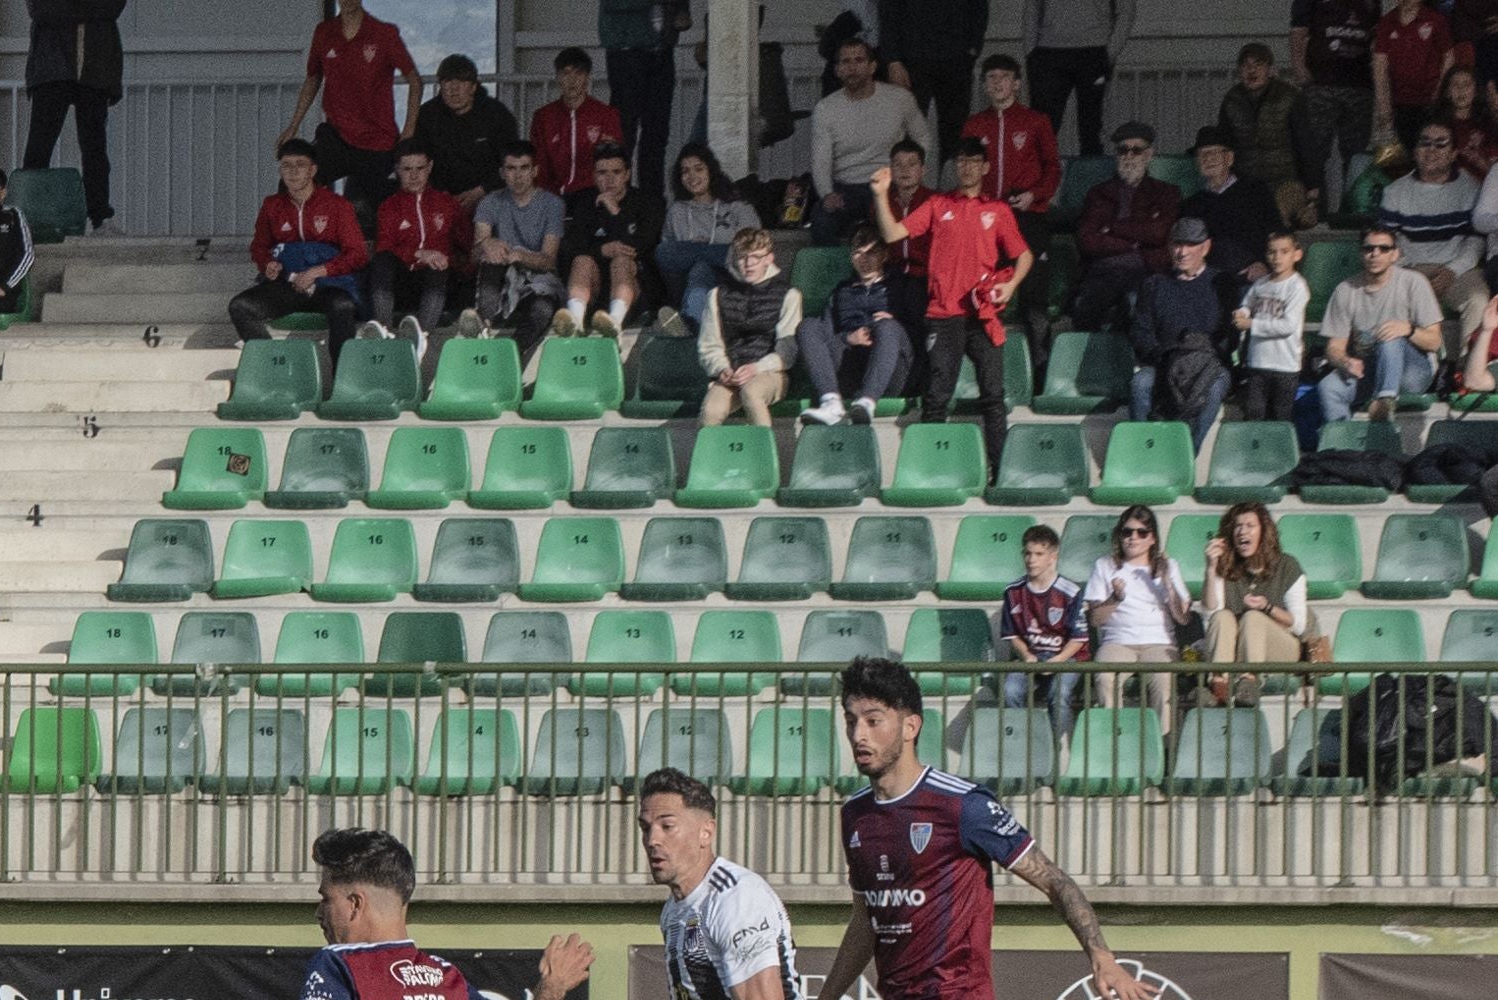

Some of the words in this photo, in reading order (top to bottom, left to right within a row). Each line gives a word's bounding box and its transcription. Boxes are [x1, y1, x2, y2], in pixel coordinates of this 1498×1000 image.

[143, 325, 161, 349] 6
[271, 355, 287, 366] 18
[370, 354, 386, 365] 17
[473, 355, 489, 366] 16
[572, 355, 587, 366] 15
[319, 444, 336, 455] 17
[422, 444, 437, 455] 16
[521, 444, 537, 455] 15
[261, 536, 276, 547] 17
[368, 534, 384, 545] 16
[468, 535, 485, 547] 15
[574, 534, 589, 544] 14
[677, 534, 694, 546] 13
[885, 532, 902, 543] 11
[106, 628, 122, 639] 18
[209, 627, 227, 638] 17
[314, 629, 329, 640] 16
[521, 629, 537, 639] 14
[625, 628, 641, 639] 13
[729, 629, 745, 640] 12
[258, 726, 274, 736] 16
